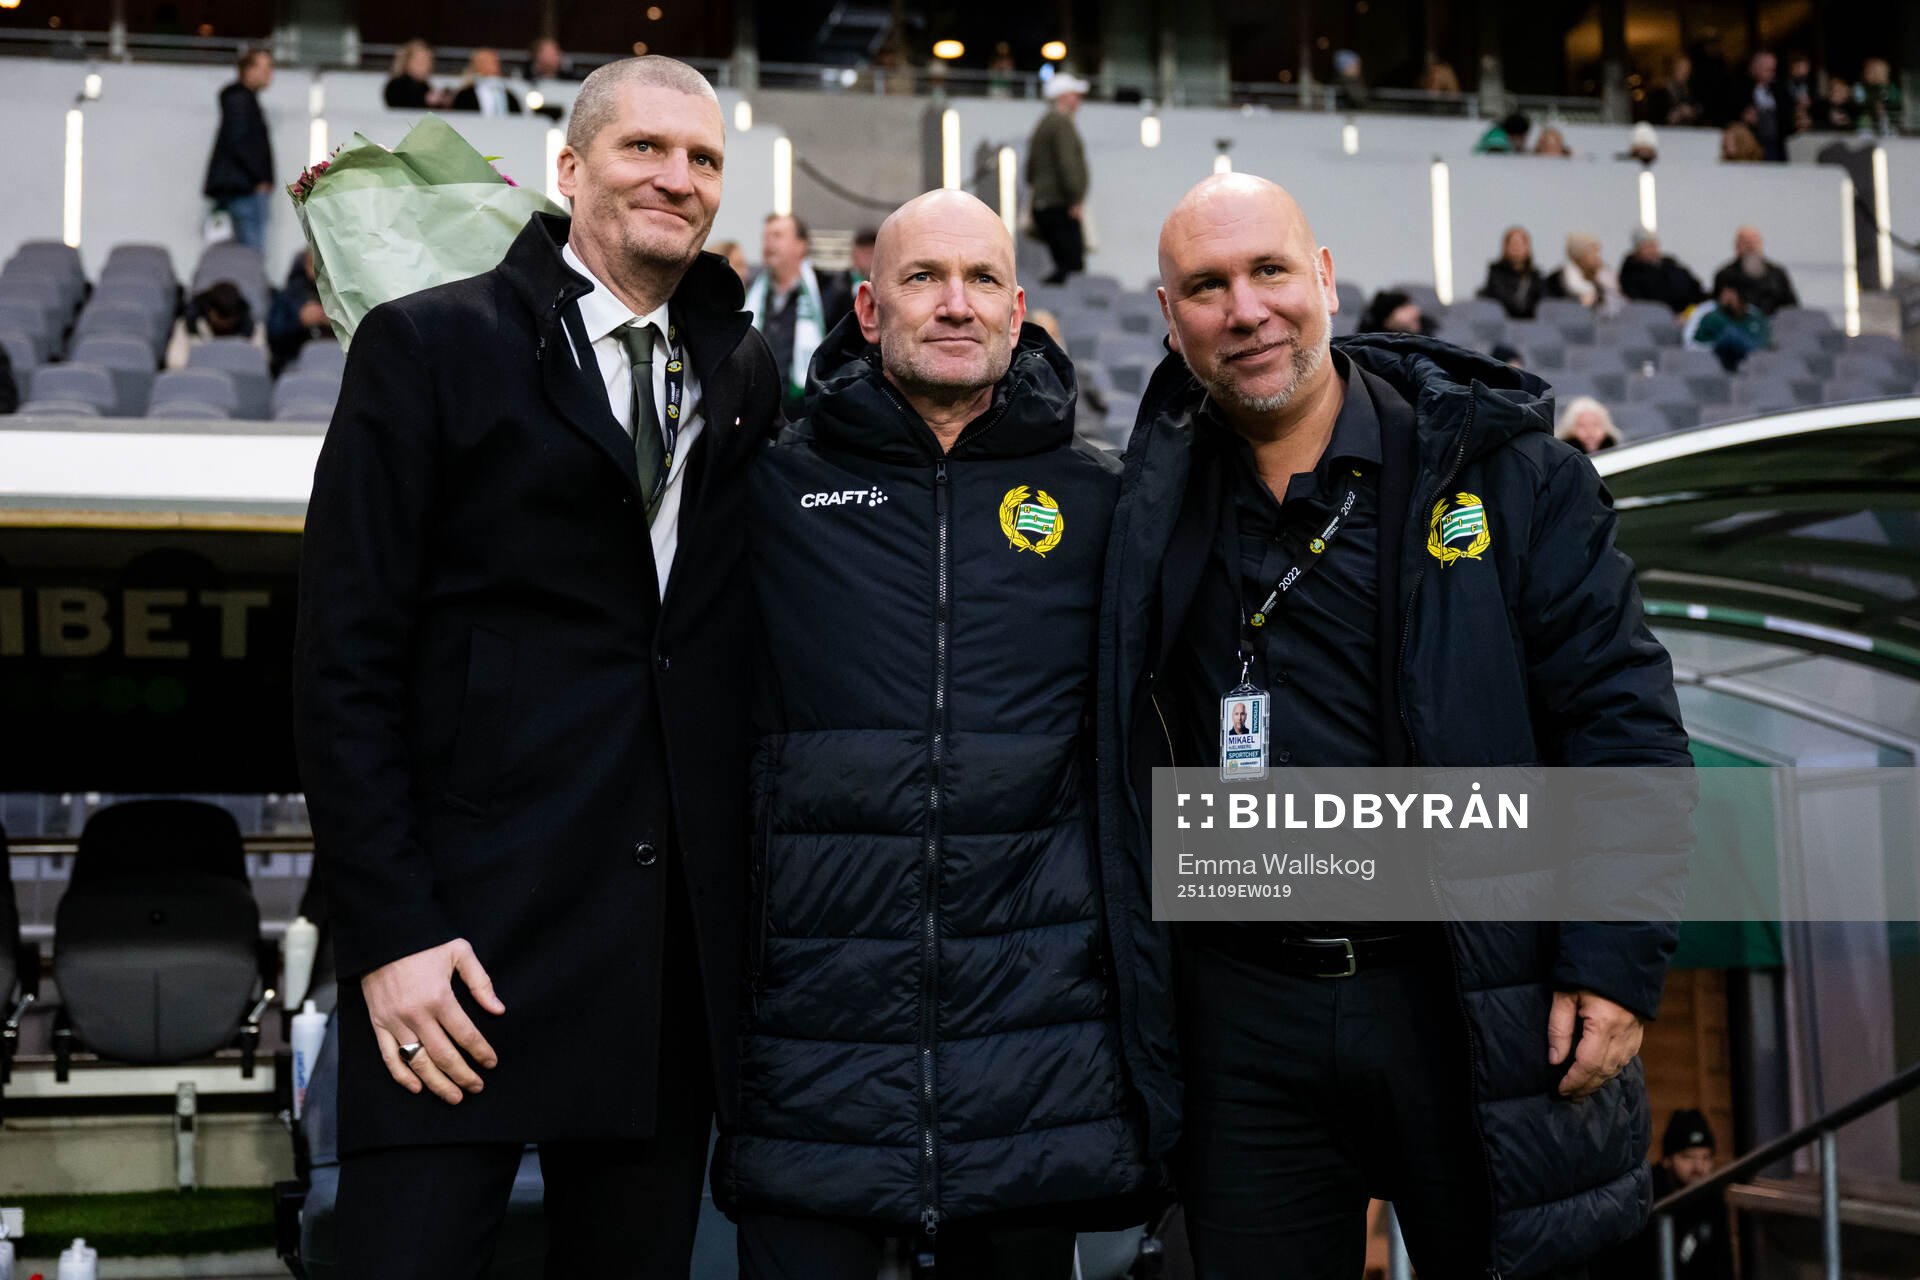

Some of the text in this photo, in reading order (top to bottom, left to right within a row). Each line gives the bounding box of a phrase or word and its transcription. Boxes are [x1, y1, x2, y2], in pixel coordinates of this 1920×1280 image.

[800, 490, 869, 508] CRAFT
[1340, 490, 1356, 516] 2022
[1278, 566, 1302, 592] 2022
[1228, 735, 1256, 745] MIKAEL
[1228, 750, 1259, 759] SPORTCHEF
